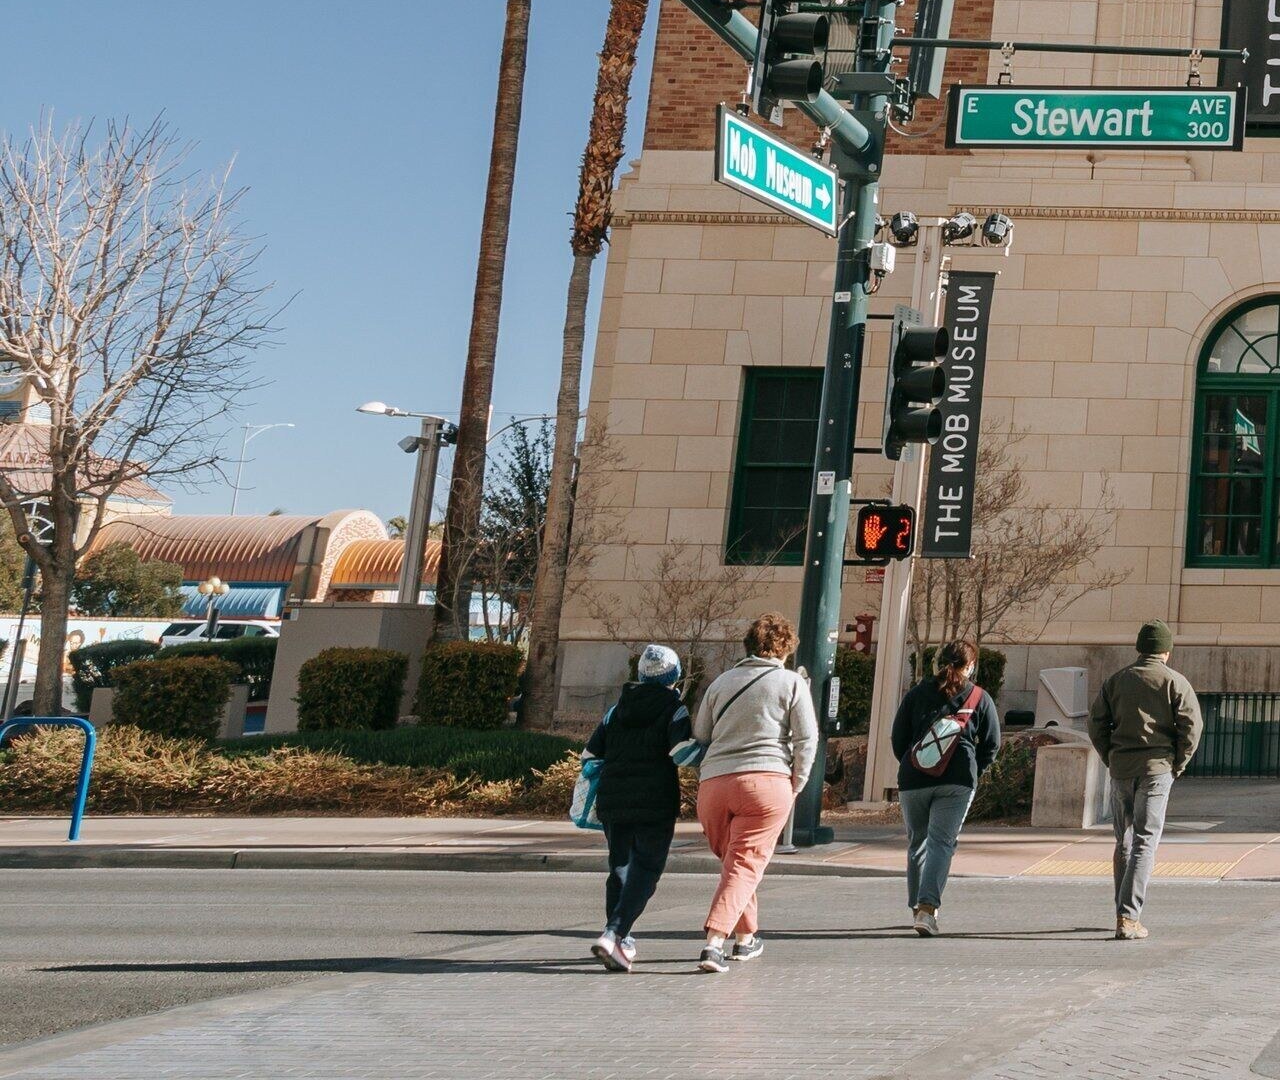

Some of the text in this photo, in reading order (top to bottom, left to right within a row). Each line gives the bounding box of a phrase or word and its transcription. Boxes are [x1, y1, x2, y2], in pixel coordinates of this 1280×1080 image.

[967, 97, 1227, 137] E Stewart AVE
[1187, 121, 1224, 138] 300
[729, 126, 813, 210] Mob Museum
[934, 285, 982, 543] THE MOB MUSEUM
[896, 518, 910, 549] 2
